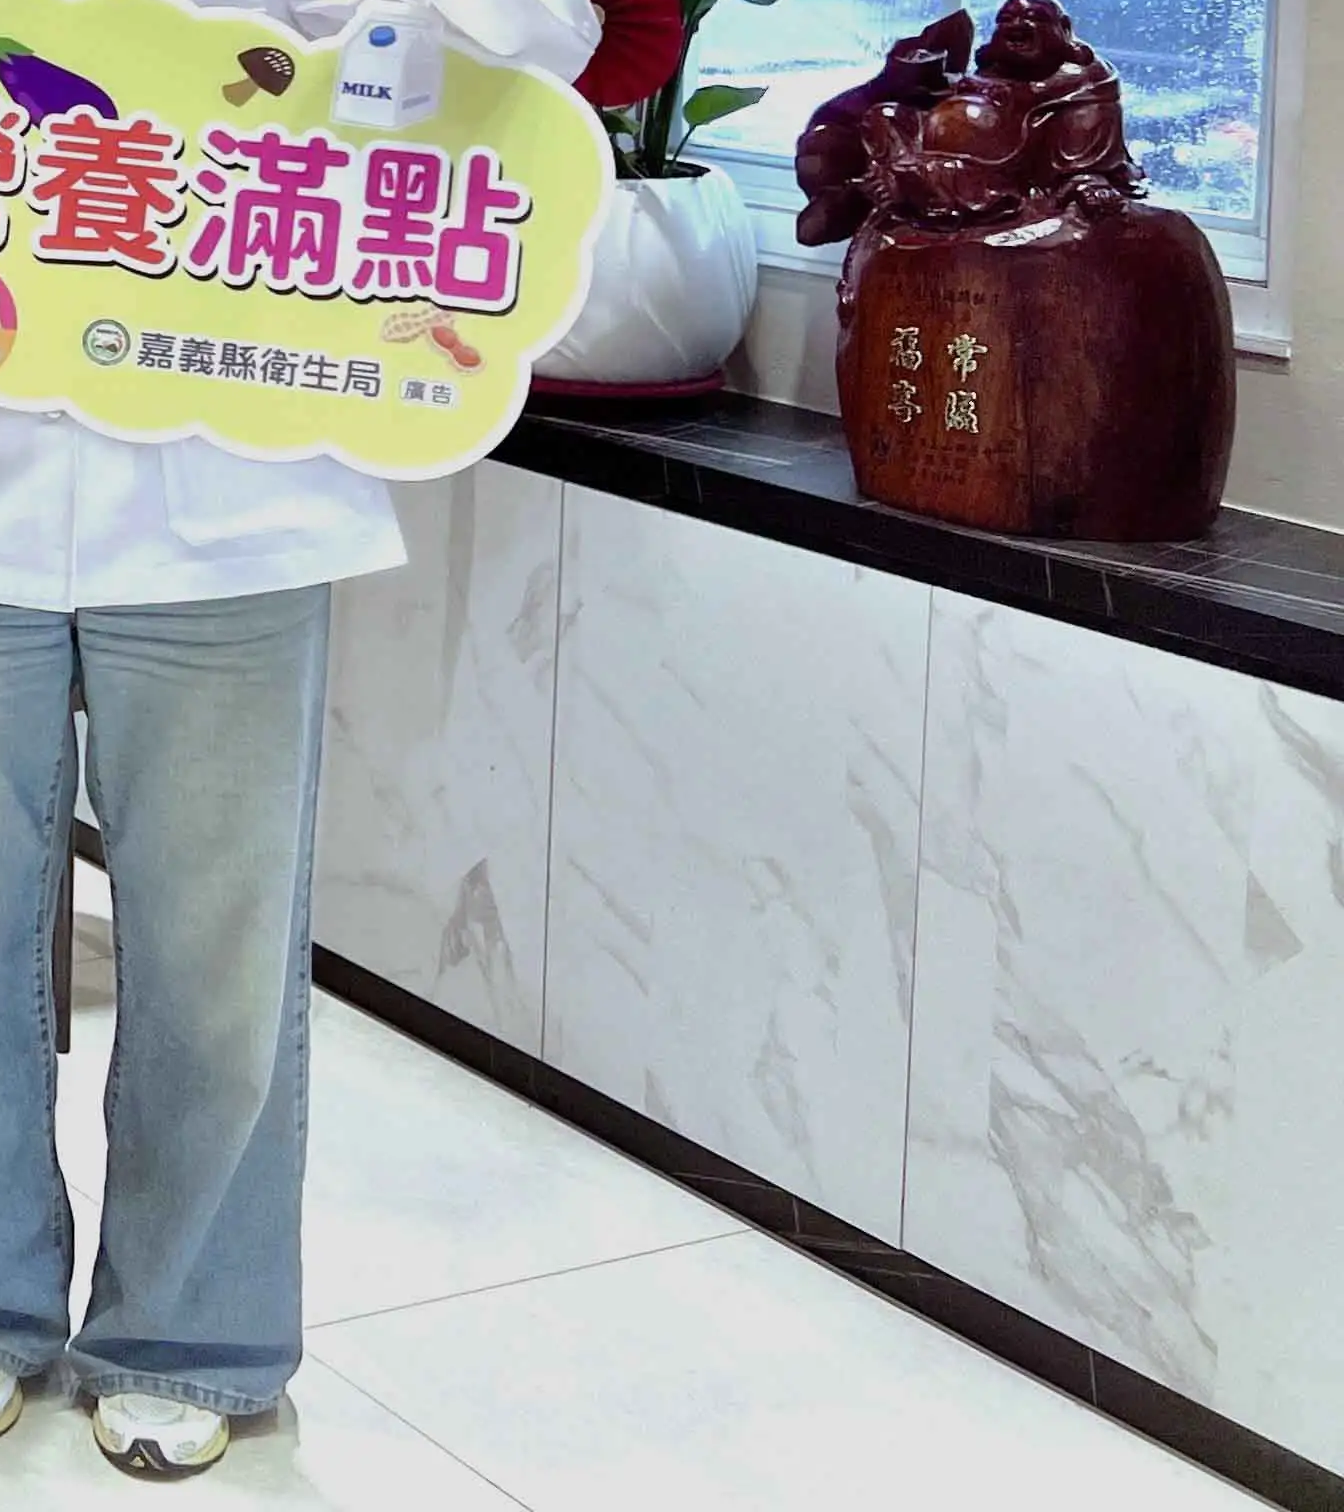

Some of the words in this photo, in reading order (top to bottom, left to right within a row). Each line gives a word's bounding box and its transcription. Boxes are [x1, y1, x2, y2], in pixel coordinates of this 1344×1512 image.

[342, 81, 393, 101] MILK
[137, 331, 381, 399] 嘉義縣衛生局
[403, 379, 452, 405] 廣告
